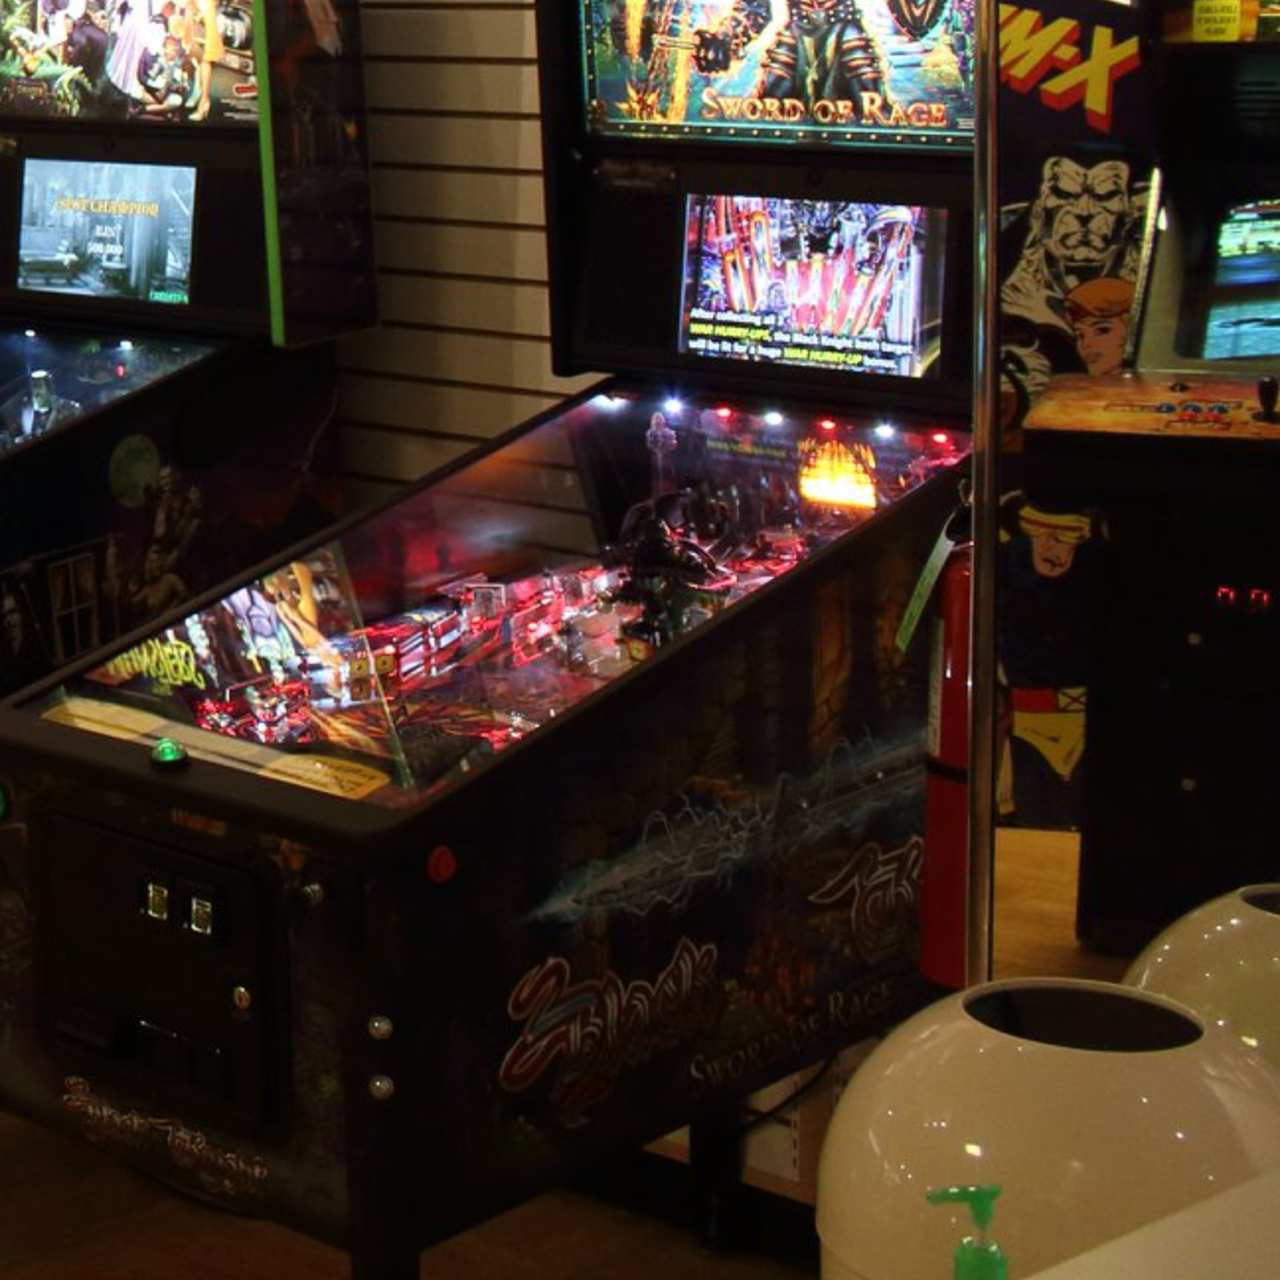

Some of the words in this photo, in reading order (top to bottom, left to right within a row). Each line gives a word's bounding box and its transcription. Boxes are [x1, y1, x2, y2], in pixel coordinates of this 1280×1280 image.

[701, 87, 805, 121] SWORD
[814, 99, 853, 123] OF
[860, 91, 948, 127] RAGE
